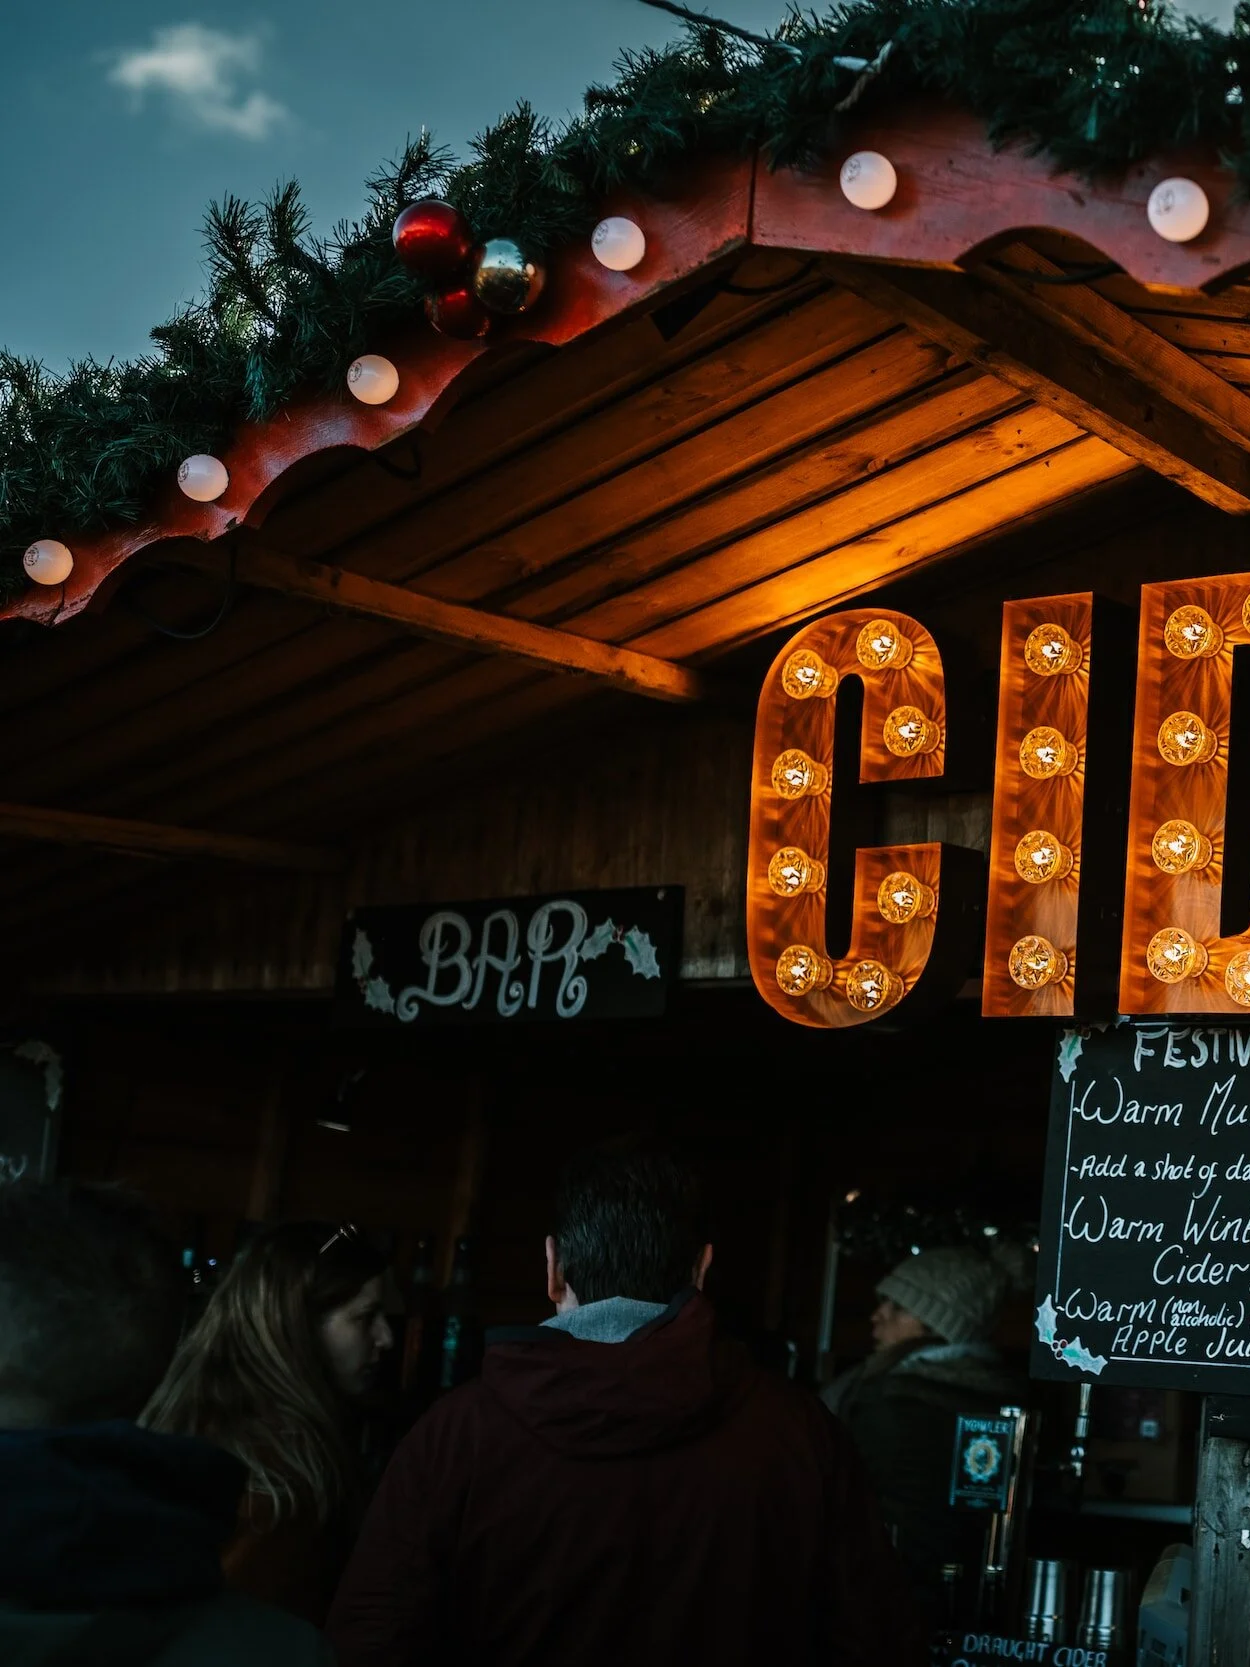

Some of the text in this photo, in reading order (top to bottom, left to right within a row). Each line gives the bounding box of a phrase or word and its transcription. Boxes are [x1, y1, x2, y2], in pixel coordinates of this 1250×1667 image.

[396, 899, 588, 1023] BAR
[1133, 1160, 1147, 1178] a
[1151, 1152, 1197, 1181] shot
[1192, 1161, 1220, 1200] of
[1152, 1244, 1250, 1286] Cider
[961, 1632, 1110, 1667] DRAUGHT CIDER
